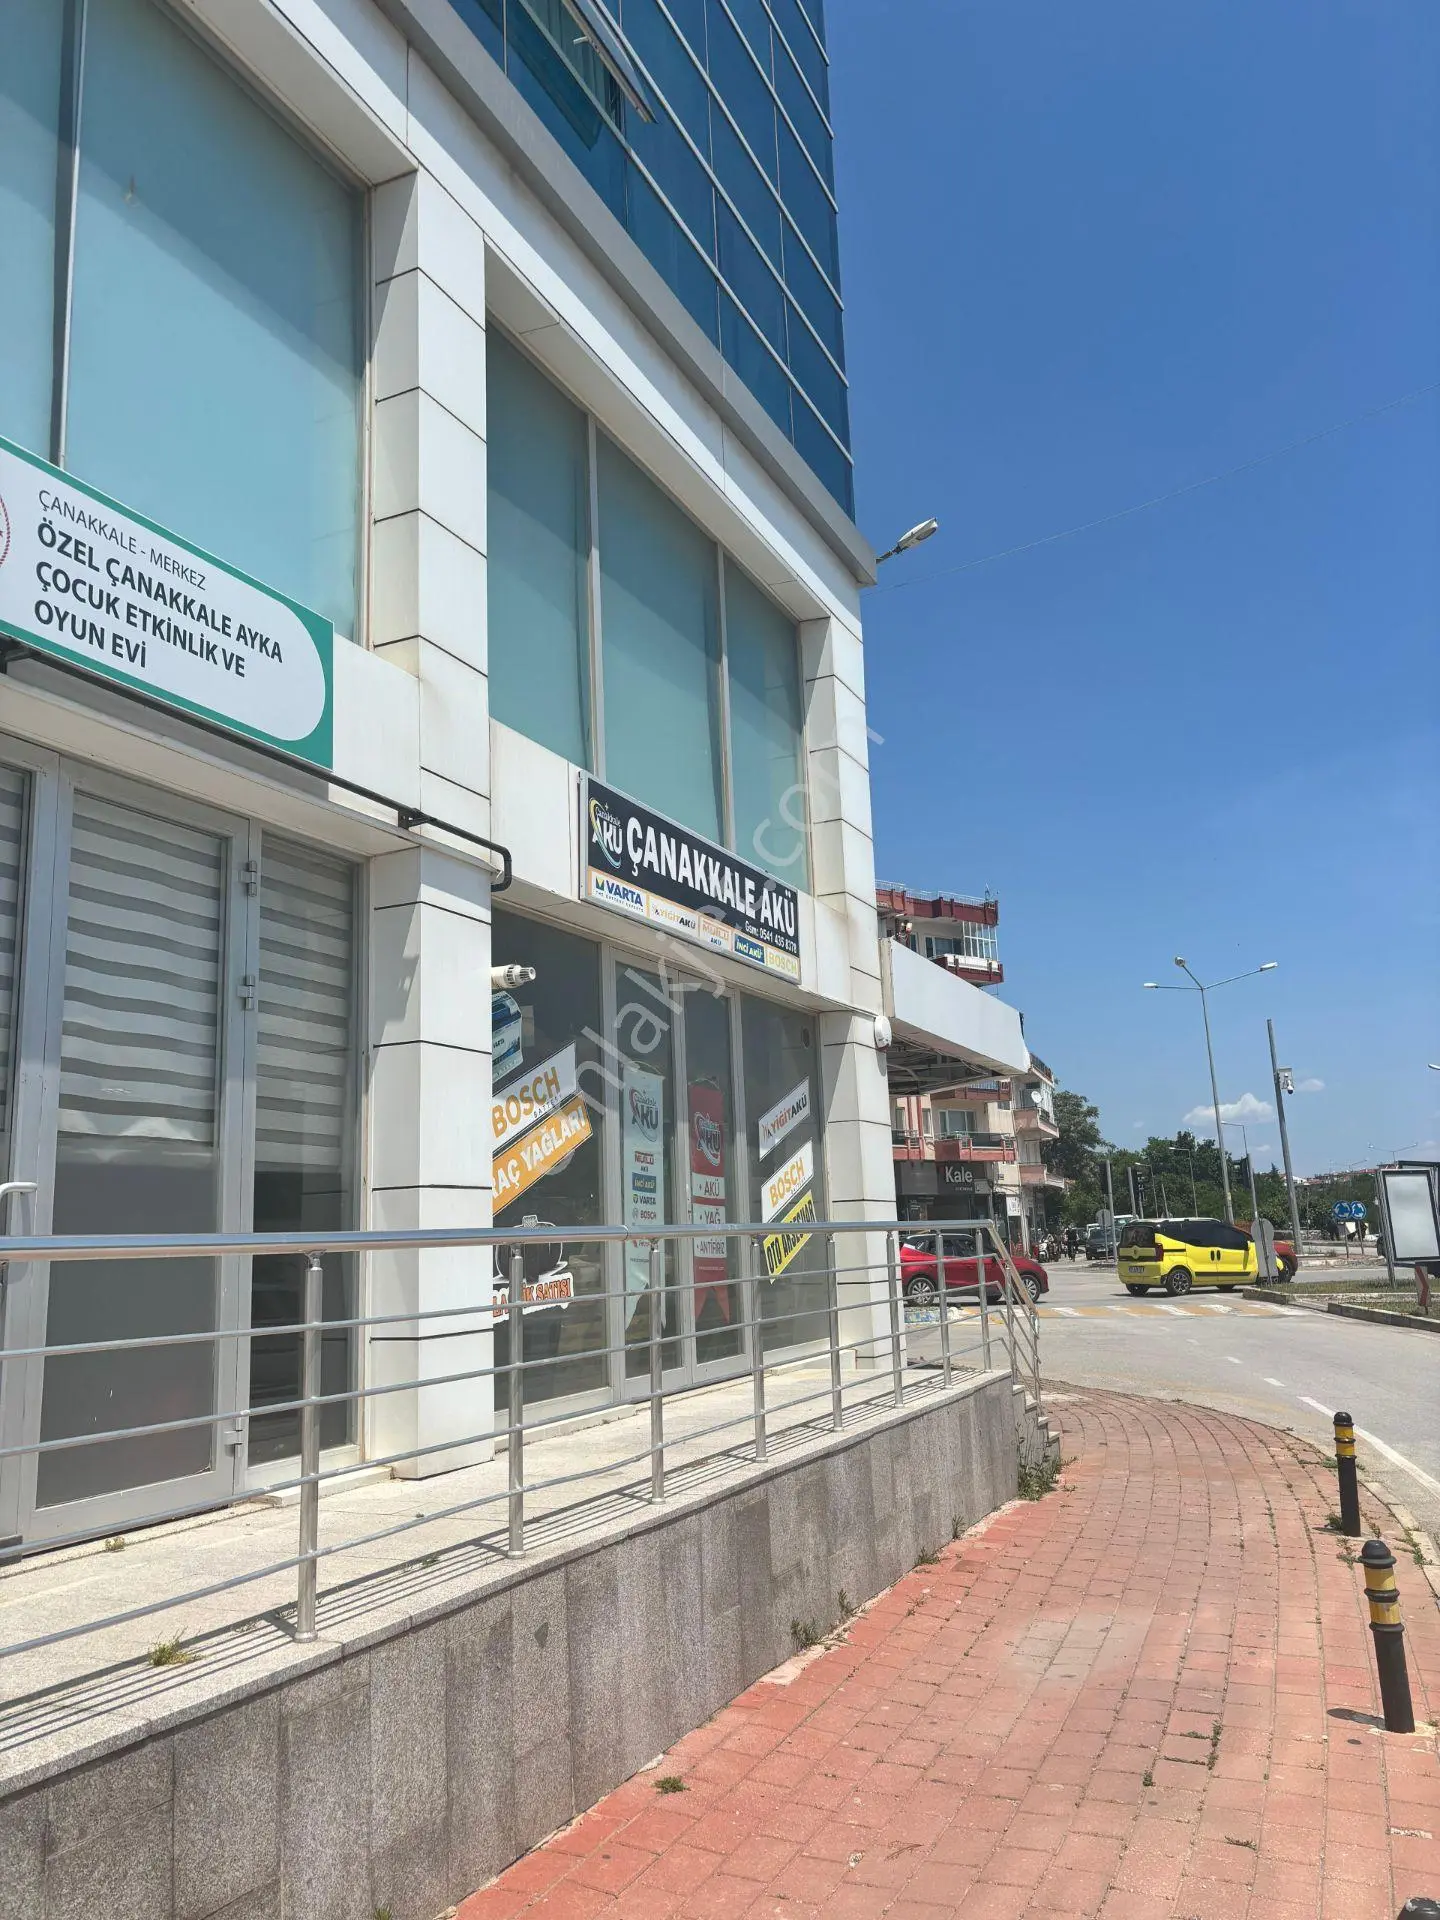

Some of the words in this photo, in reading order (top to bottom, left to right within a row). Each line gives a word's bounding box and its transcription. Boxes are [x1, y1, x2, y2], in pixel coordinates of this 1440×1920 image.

[38, 489, 137, 555] ÇANAKKALE
[149, 548, 206, 591] MERKEZ
[37, 517, 100, 573] ÖZEL
[105, 557, 232, 637] ÇANAKKALE
[235, 623, 282, 663] AYKA
[34, 599, 105, 650] OYUN
[111, 633, 146, 668] EVİ
[35, 561, 120, 620] ÇOCUK
[125, 602, 218, 666] ETKİNLİK
[221, 647, 245, 678] VE
[606, 880, 643, 907] VARTA
[626, 817, 756, 919] ÇANAKKALE
[760, 888, 795, 936] AKÜ
[745, 920, 759, 937] Gsm:
[760, 928, 773, 943] 0541
[768, 951, 797, 974] BOSCH
[492, 1067, 560, 1138] BOSCH
[492, 1158, 521, 1199] AÇ
[520, 1106, 586, 1171] YAĞLARI
[945, 1166, 973, 1183] Kale
[704, 1178, 720, 1197] AKÜ
[769, 1157, 805, 1208] BOSCH
[704, 1208, 721, 1225] YAĞ
[766, 1234, 783, 1274] OTO
